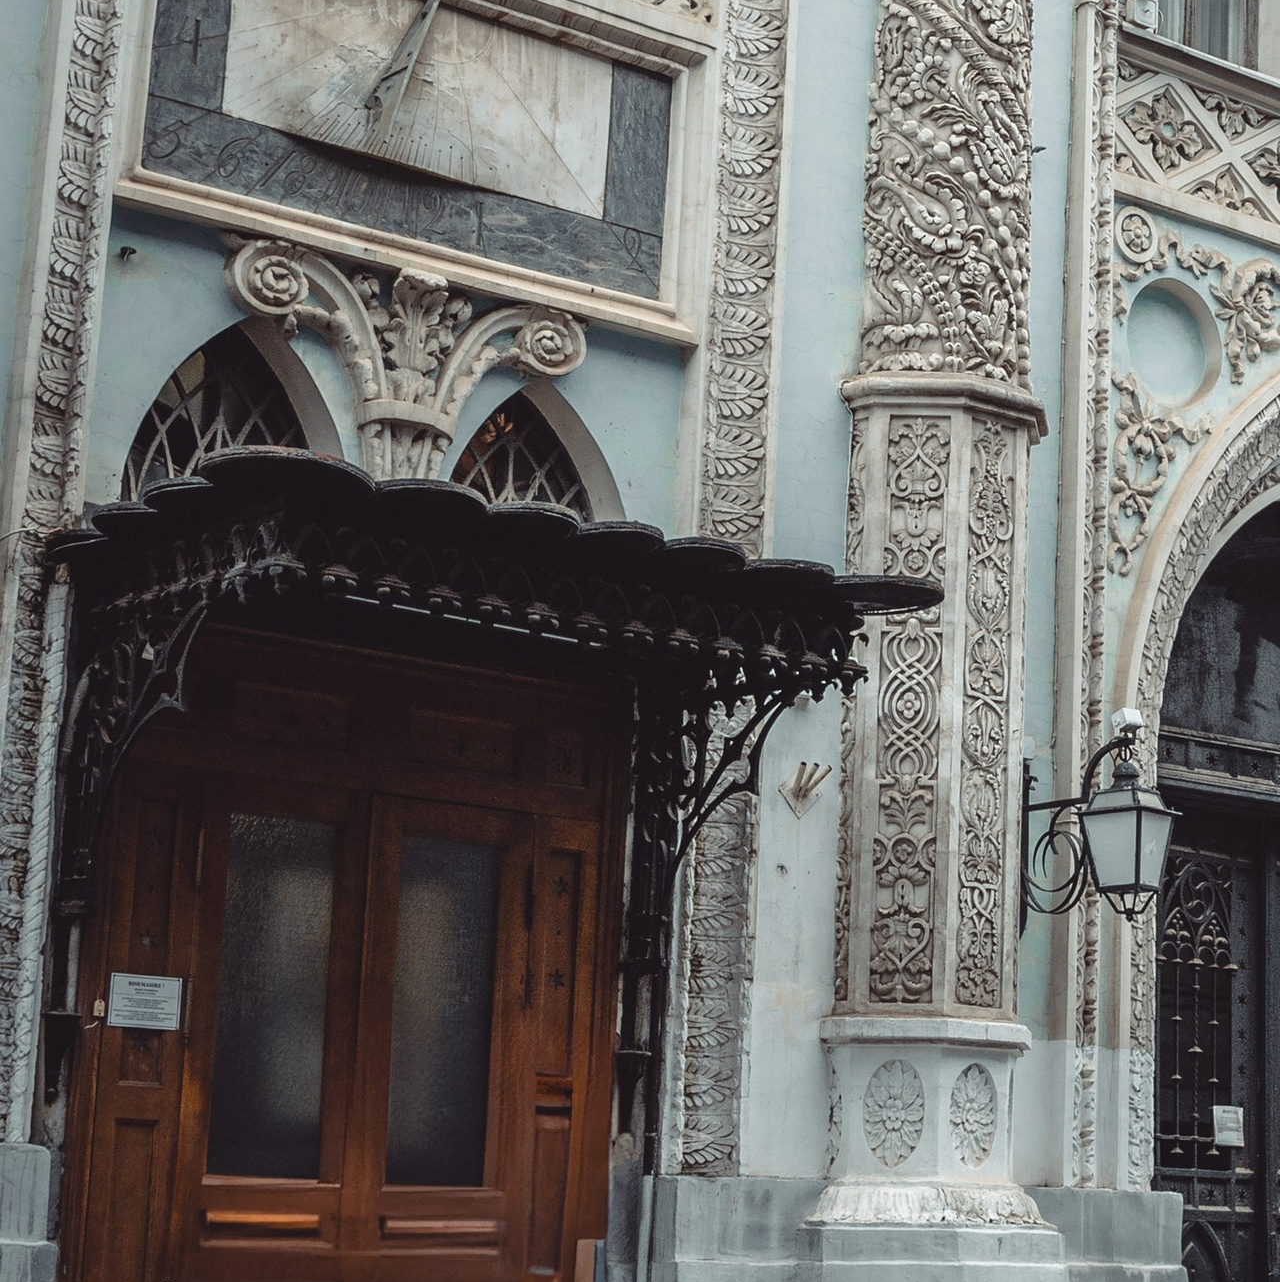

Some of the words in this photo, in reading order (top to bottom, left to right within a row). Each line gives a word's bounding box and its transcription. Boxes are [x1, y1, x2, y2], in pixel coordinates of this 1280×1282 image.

[149, 120, 192, 159] 5
[217, 137, 259, 178] 6
[282, 154, 318, 195] 8
[623, 228, 643, 273] 2
